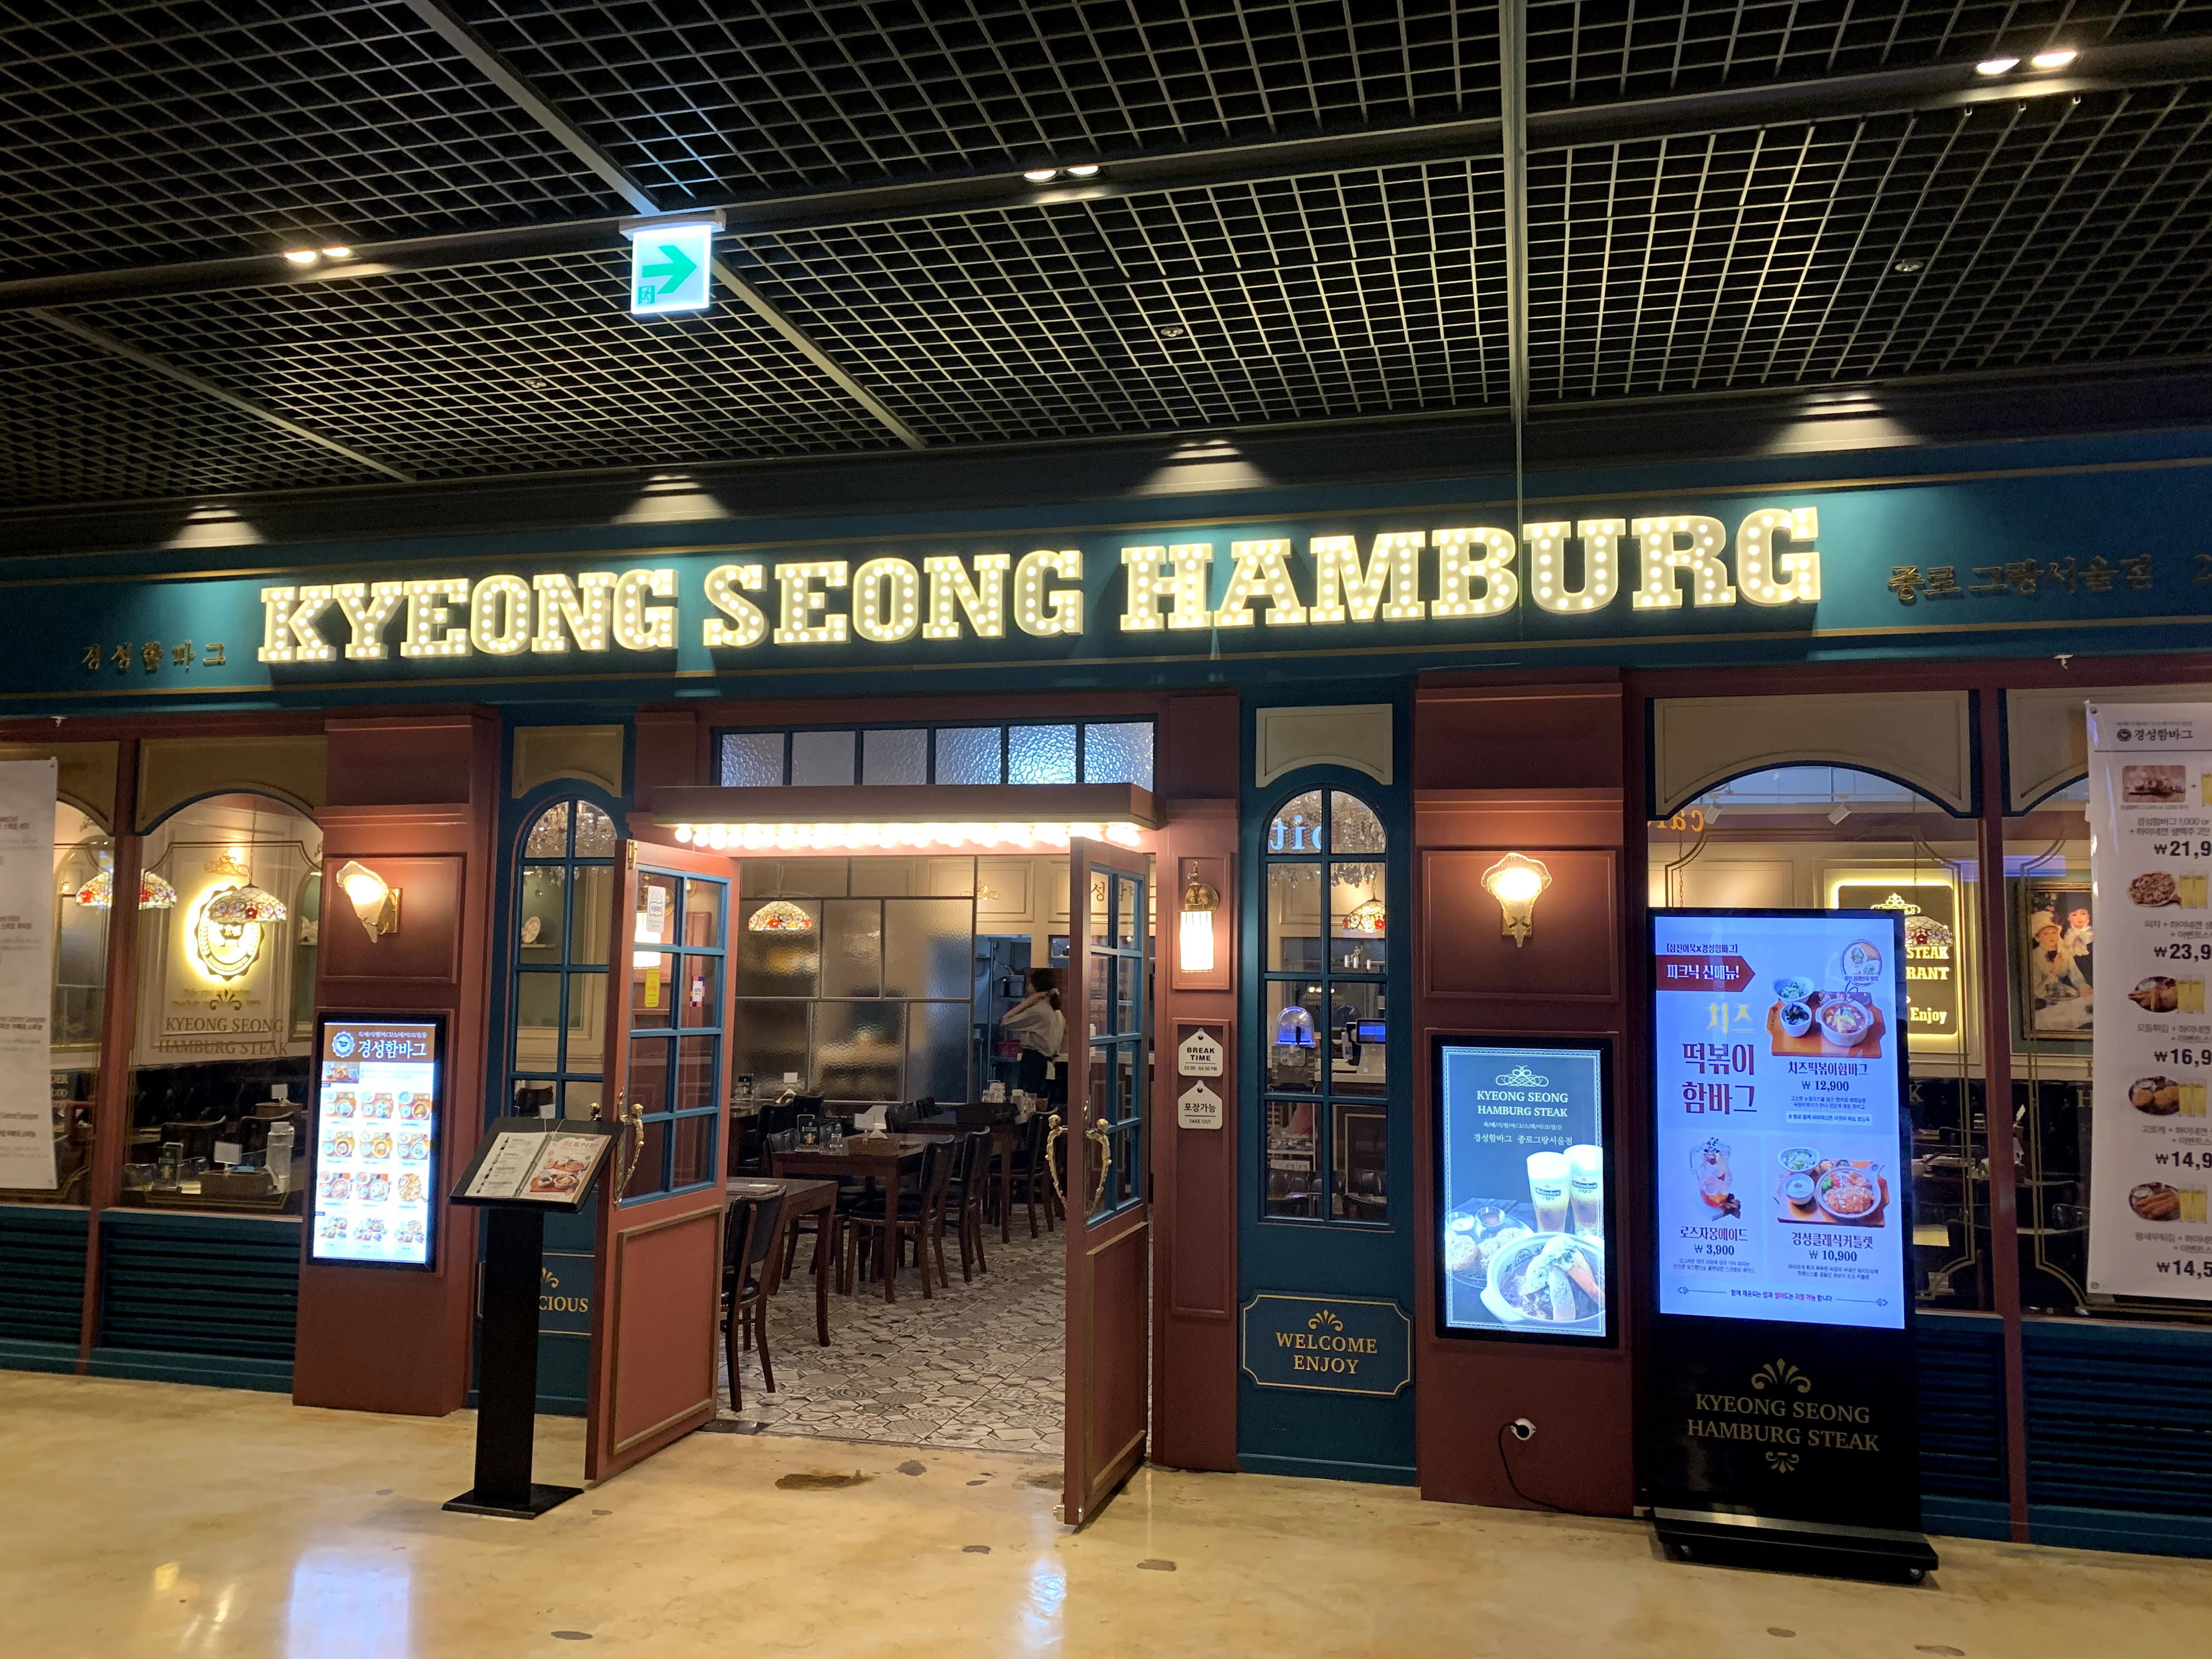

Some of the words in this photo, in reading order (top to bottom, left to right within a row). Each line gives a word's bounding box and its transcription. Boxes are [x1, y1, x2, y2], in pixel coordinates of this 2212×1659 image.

[258, 568, 679, 662] KYEONG
[703, 550, 1084, 648] SEONG
[1120, 506, 1821, 631] HAMBURG
[2134, 729, 2193, 741] 경성함바그
[1906, 946, 1949, 959] STEAK
[1667, 964, 1700, 979] 피크닉
[1702, 965, 1740, 980] 신메뉴!
[1707, 1002, 1756, 1034] 치즈
[1910, 1007, 1947, 1024] Enjoy
[166, 1017, 227, 1032] KYEONG
[232, 1018, 284, 1032] SEONG
[158, 1039, 236, 1054] HAMBURG
[240, 1042, 289, 1056] STEAK
[358, 1040, 427, 1059] 경성함바그
[1682, 1043, 1754, 1076] 떡볶이
[1788, 1061, 1868, 1076] 치즈떡볶이함바그
[1815, 1081, 1849, 1093] 12,900
[1476, 1090, 1525, 1102] KYEONG
[1528, 1092, 1568, 1103] SEONG
[1682, 1081, 1757, 1115] 함바그
[1184, 1103, 1216, 1113] 포장가능
[1477, 1105, 1532, 1116] HAMBURG
[1534, 1107, 1568, 1118] STEAK
[1474, 1133, 1513, 1143] 경성함바그
[1517, 1135, 1573, 1146] 종로그랑서울점
[1680, 1226, 1749, 1242] 로즈자몽에이드
[1706, 1244, 1735, 1256] 3,900
[1822, 1250, 1858, 1262] 10,900
[1276, 1332, 1378, 1353] WELCOME
[1294, 1355, 1359, 1374] ENJOY
[1695, 1393, 1787, 1417] KYEONG
[1793, 1401, 1870, 1424] SEONG
[1687, 1419, 1801, 1444] HAMBURG
[1808, 1429, 1881, 1452] STEAK
